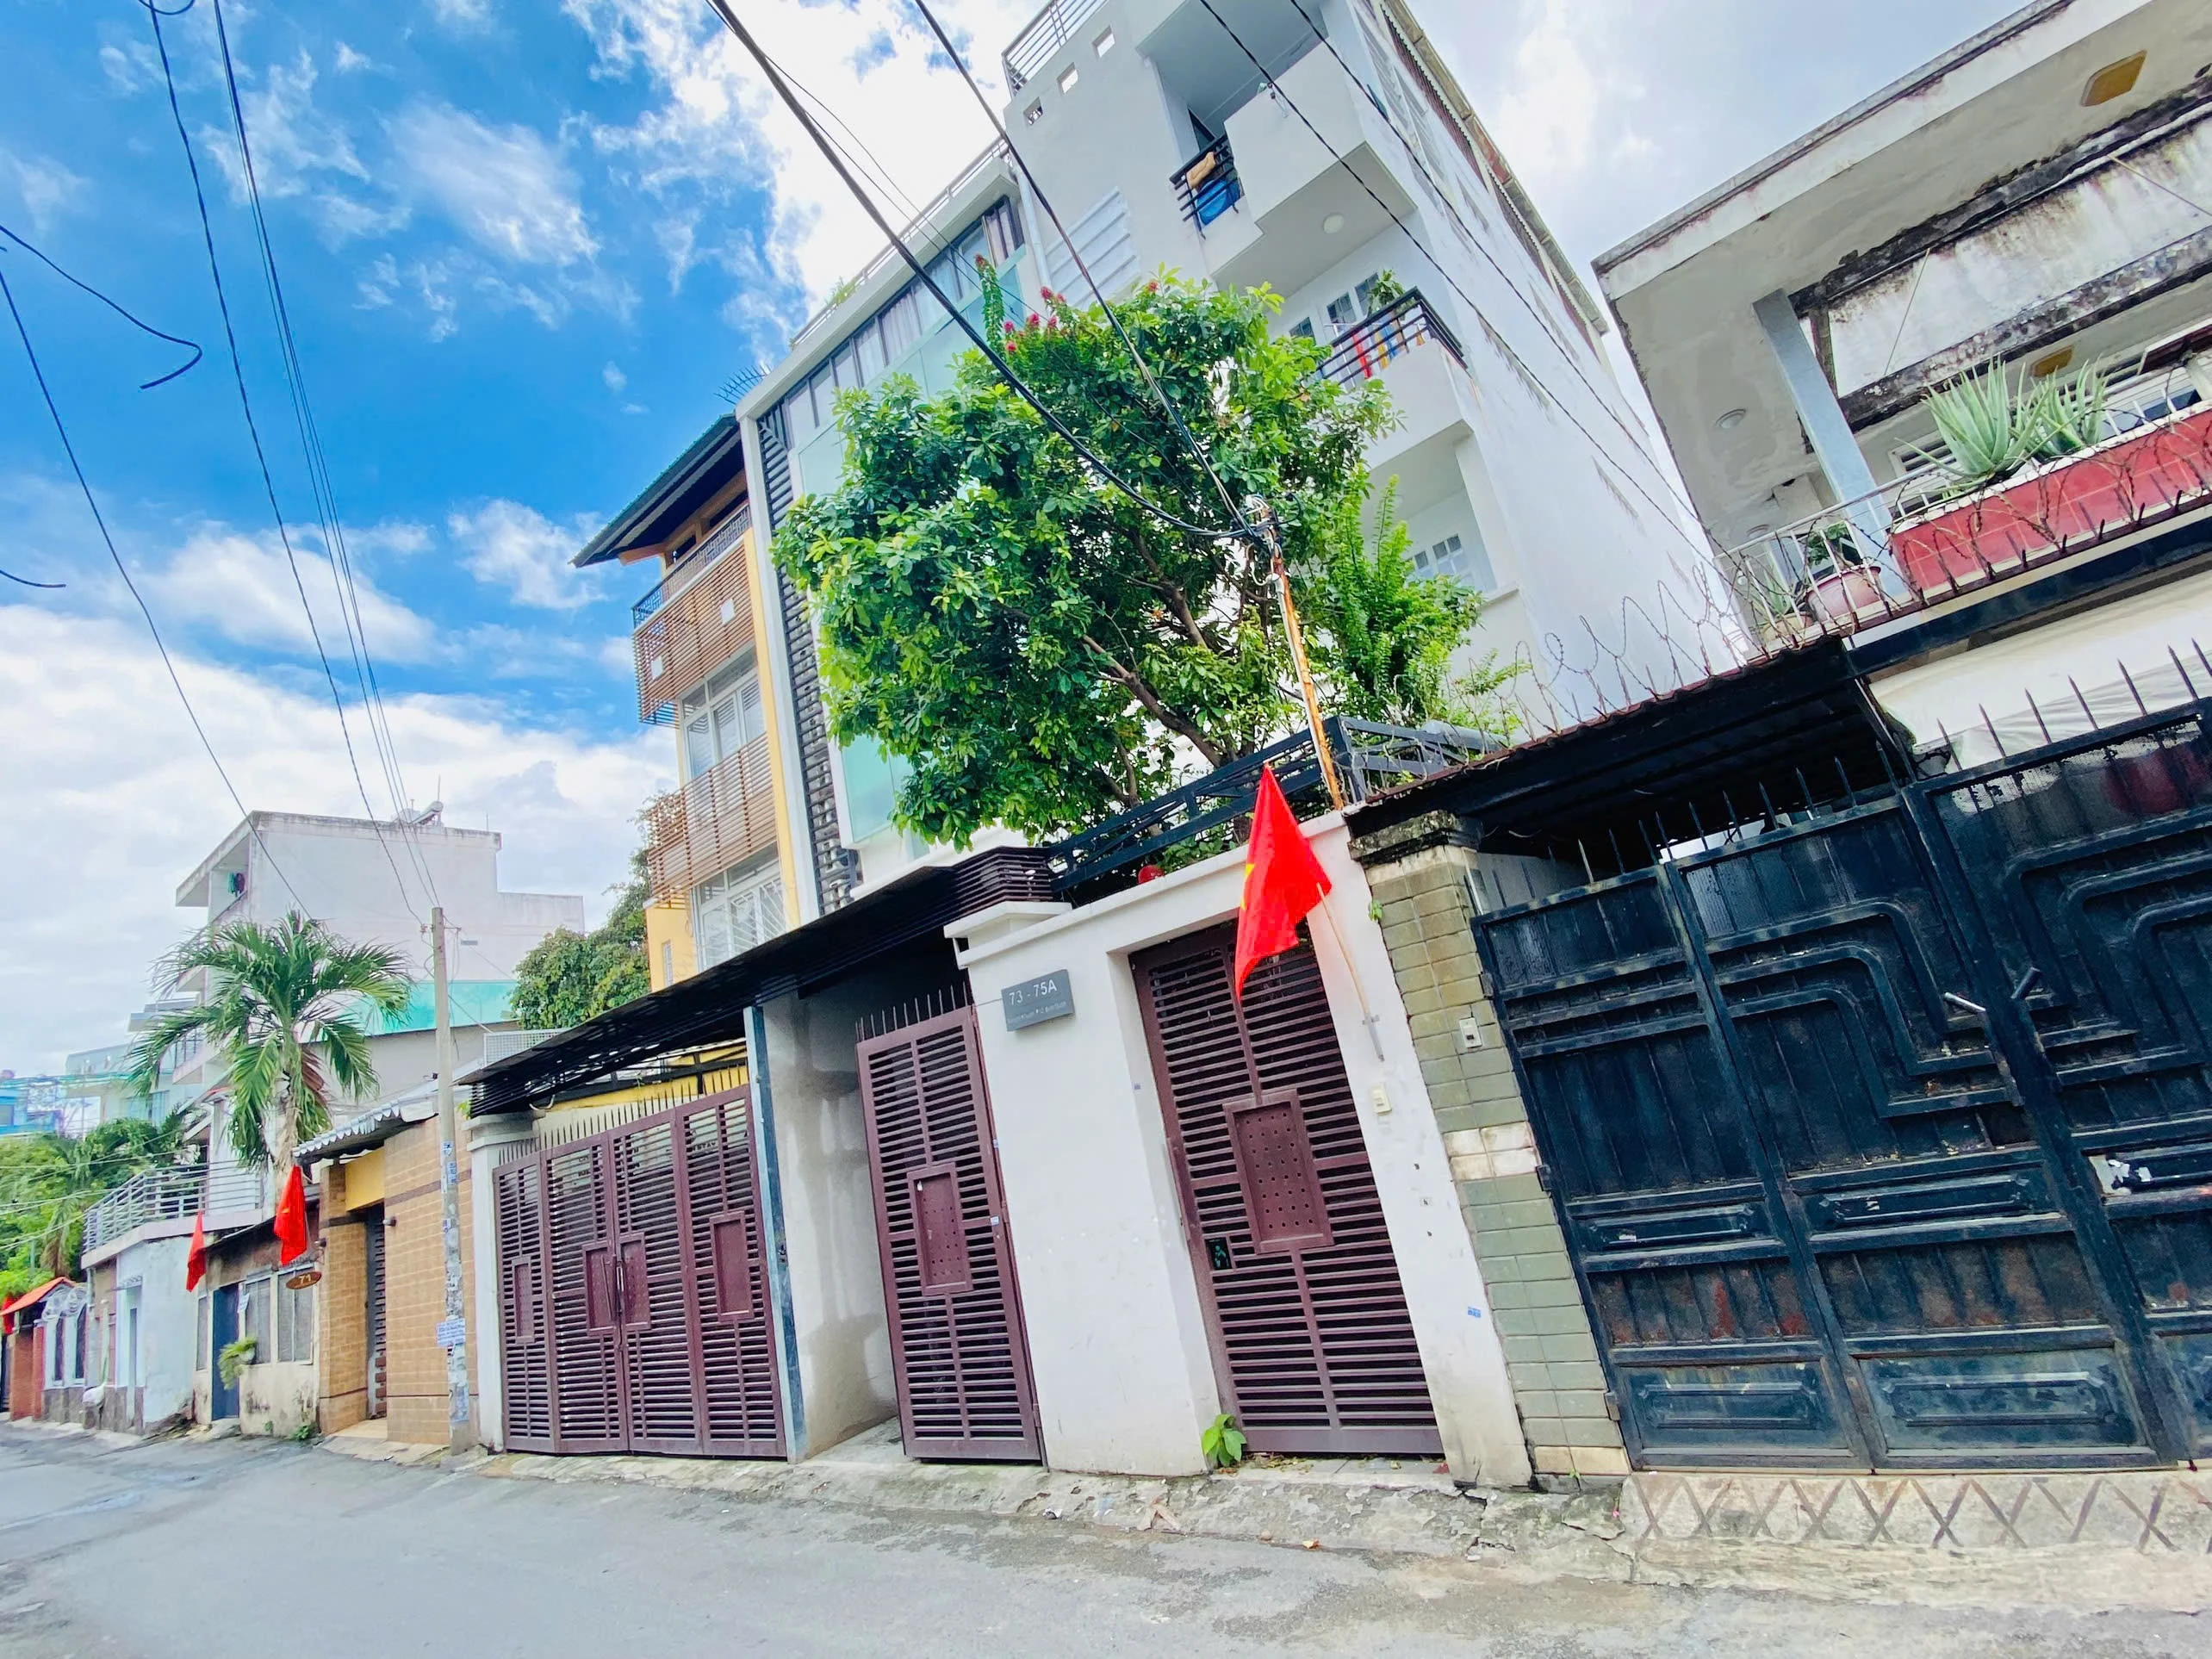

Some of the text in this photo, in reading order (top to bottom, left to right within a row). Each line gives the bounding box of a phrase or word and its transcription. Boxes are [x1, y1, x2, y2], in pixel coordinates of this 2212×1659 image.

[1009, 990, 1023, 1005] 73
[1034, 979, 1057, 997] 75A
[298, 1274, 311, 1283] 71
